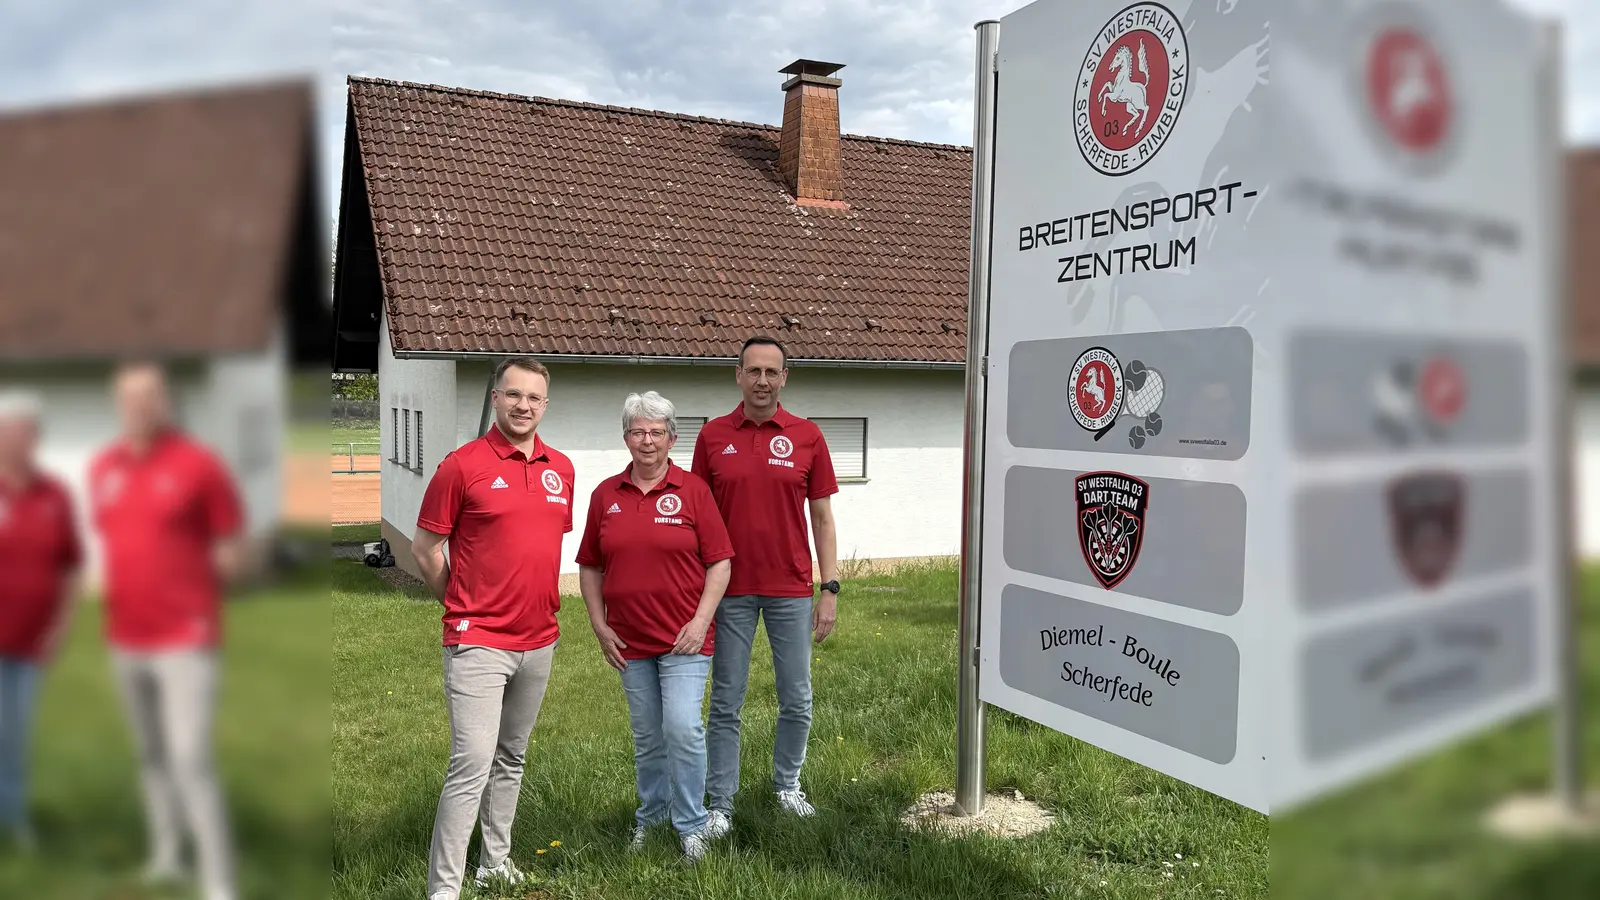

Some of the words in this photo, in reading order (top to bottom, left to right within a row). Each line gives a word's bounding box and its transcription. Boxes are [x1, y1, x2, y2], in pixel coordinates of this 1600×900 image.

[1086, 43, 1102, 72] SV
[1103, 9, 1175, 44] WESTFALIA
[1077, 99, 1128, 170] SCHERFEDE
[1138, 64, 1184, 160] RIMBECK
[1103, 119, 1119, 137] 03
[1019, 182, 1258, 251] BREITENSPORT-
[1057, 236, 1196, 283] ZENTRUM
[1074, 360, 1083, 375] SV
[1083, 350, 1118, 374] WESTFALIA
[1070, 385, 1097, 428] SCHERFEDE
[1100, 385, 1122, 426] RIMBECK
[1083, 401, 1092, 410] 03
[1077, 479, 1087, 492] SV
[1088, 477, 1130, 492] WESTFALIA
[1131, 483, 1143, 497] 03
[1083, 490, 1109, 505] DART
[1110, 491, 1138, 511] TEAM
[654, 517, 682, 525] VORSTAND
[1040, 625, 1103, 651] Diemel
[1121, 635, 1181, 687] Boule
[1060, 661, 1154, 707] Scherfede
